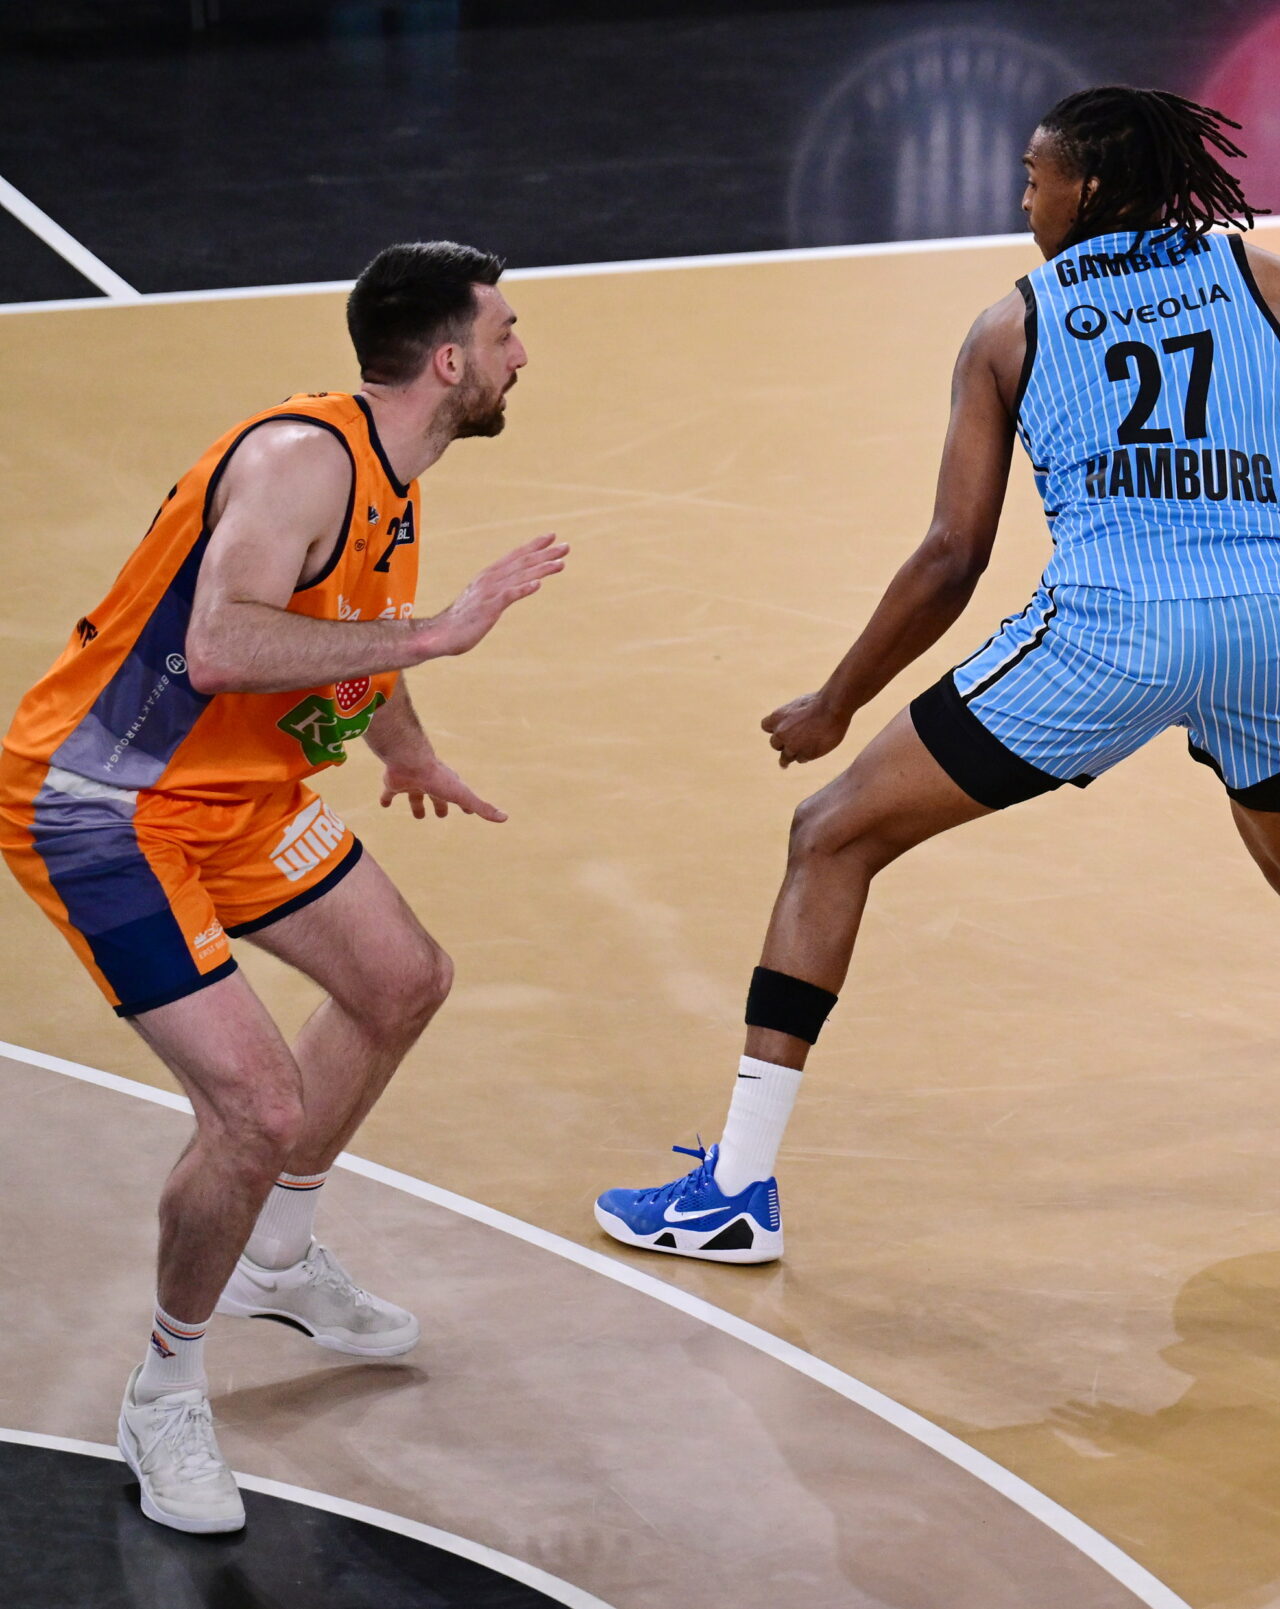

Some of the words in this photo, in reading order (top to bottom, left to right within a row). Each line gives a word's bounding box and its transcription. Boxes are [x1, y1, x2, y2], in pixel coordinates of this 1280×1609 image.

[1112, 283, 1231, 325] VEOLIA
[1104, 328, 1213, 445] 27
[1084, 447, 1277, 504] HAMBURG
[103, 674, 170, 772] BREAKTHROUGH
